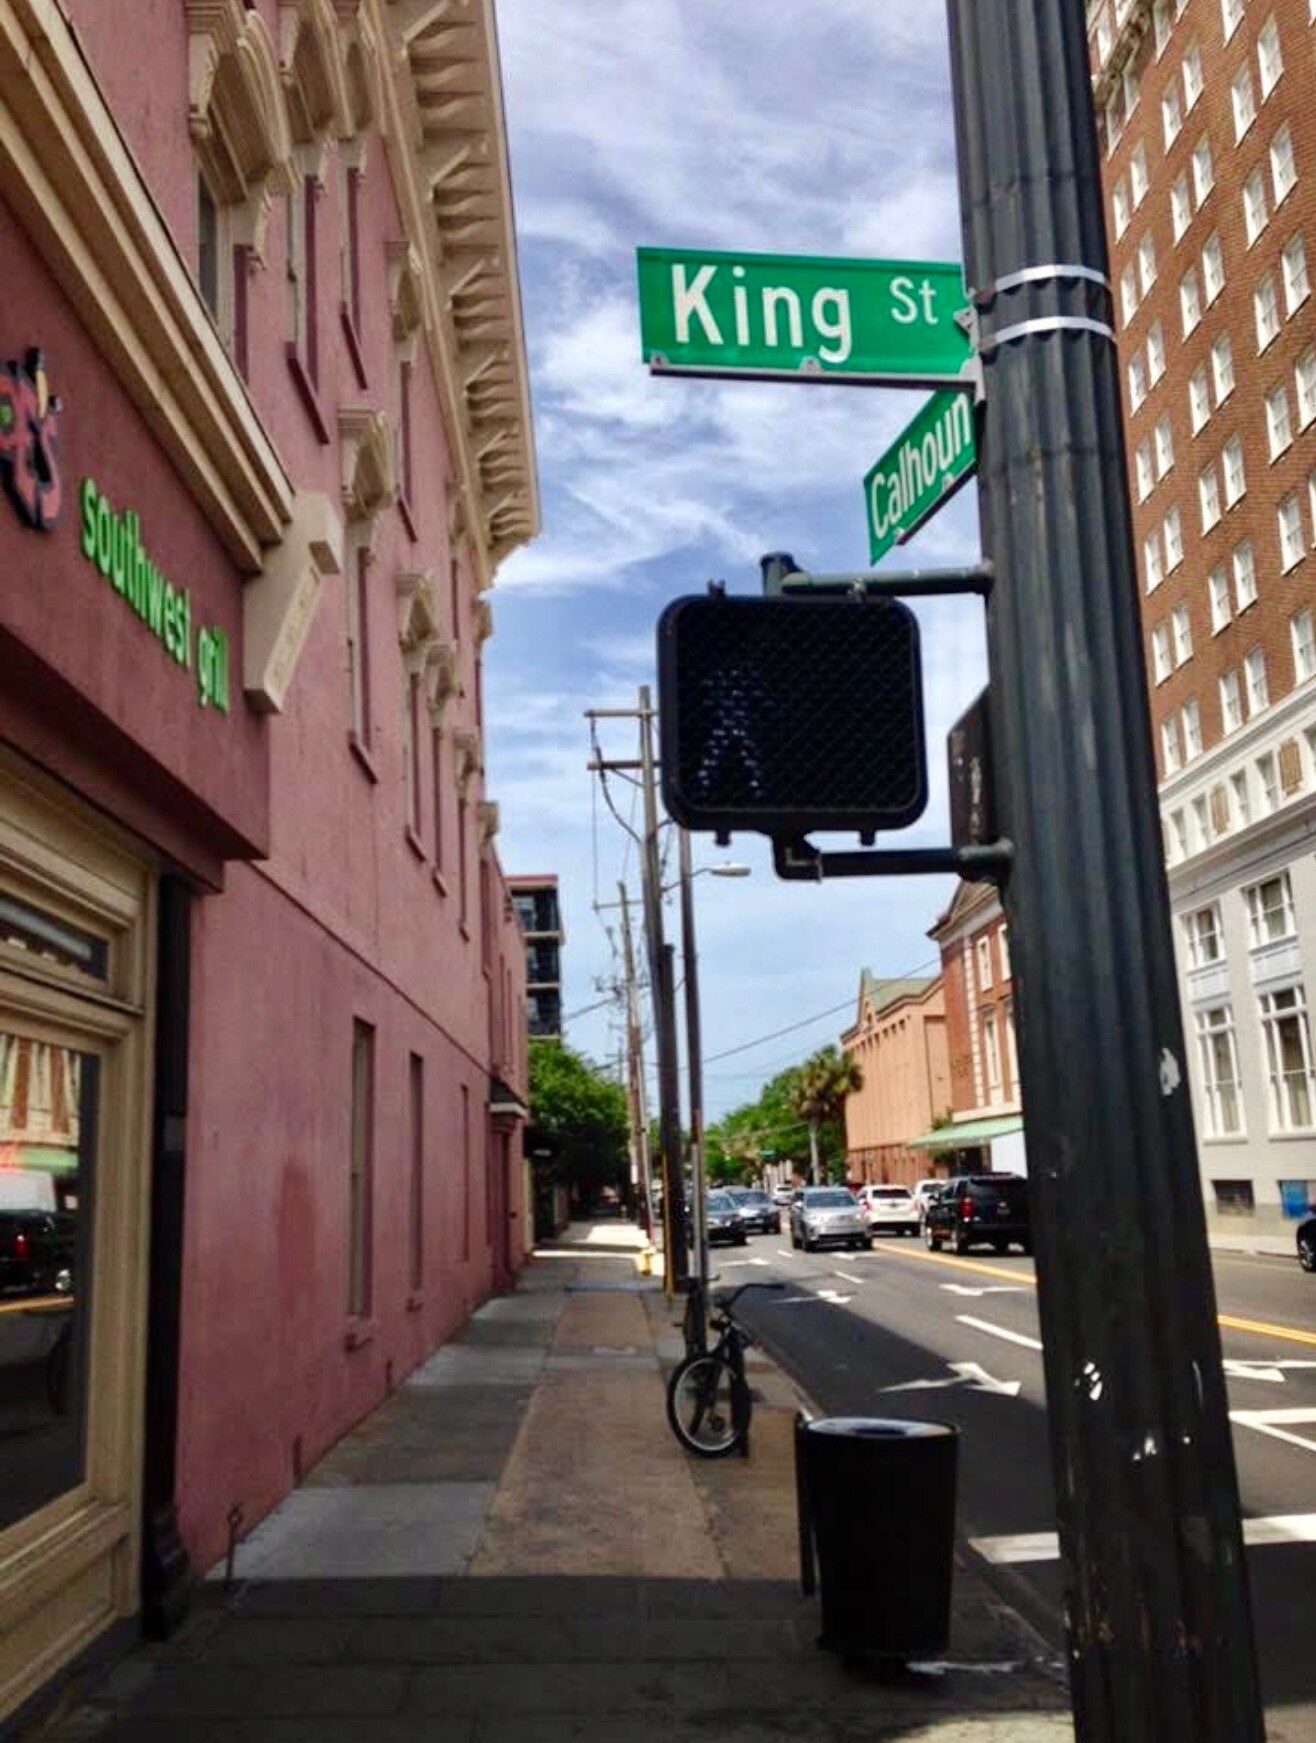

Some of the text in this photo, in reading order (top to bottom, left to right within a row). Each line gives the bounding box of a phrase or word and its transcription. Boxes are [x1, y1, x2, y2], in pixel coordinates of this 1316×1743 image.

[671, 263, 939, 363] King St
[870, 393, 972, 541] Calhoun
[82, 477, 191, 668] southwest
